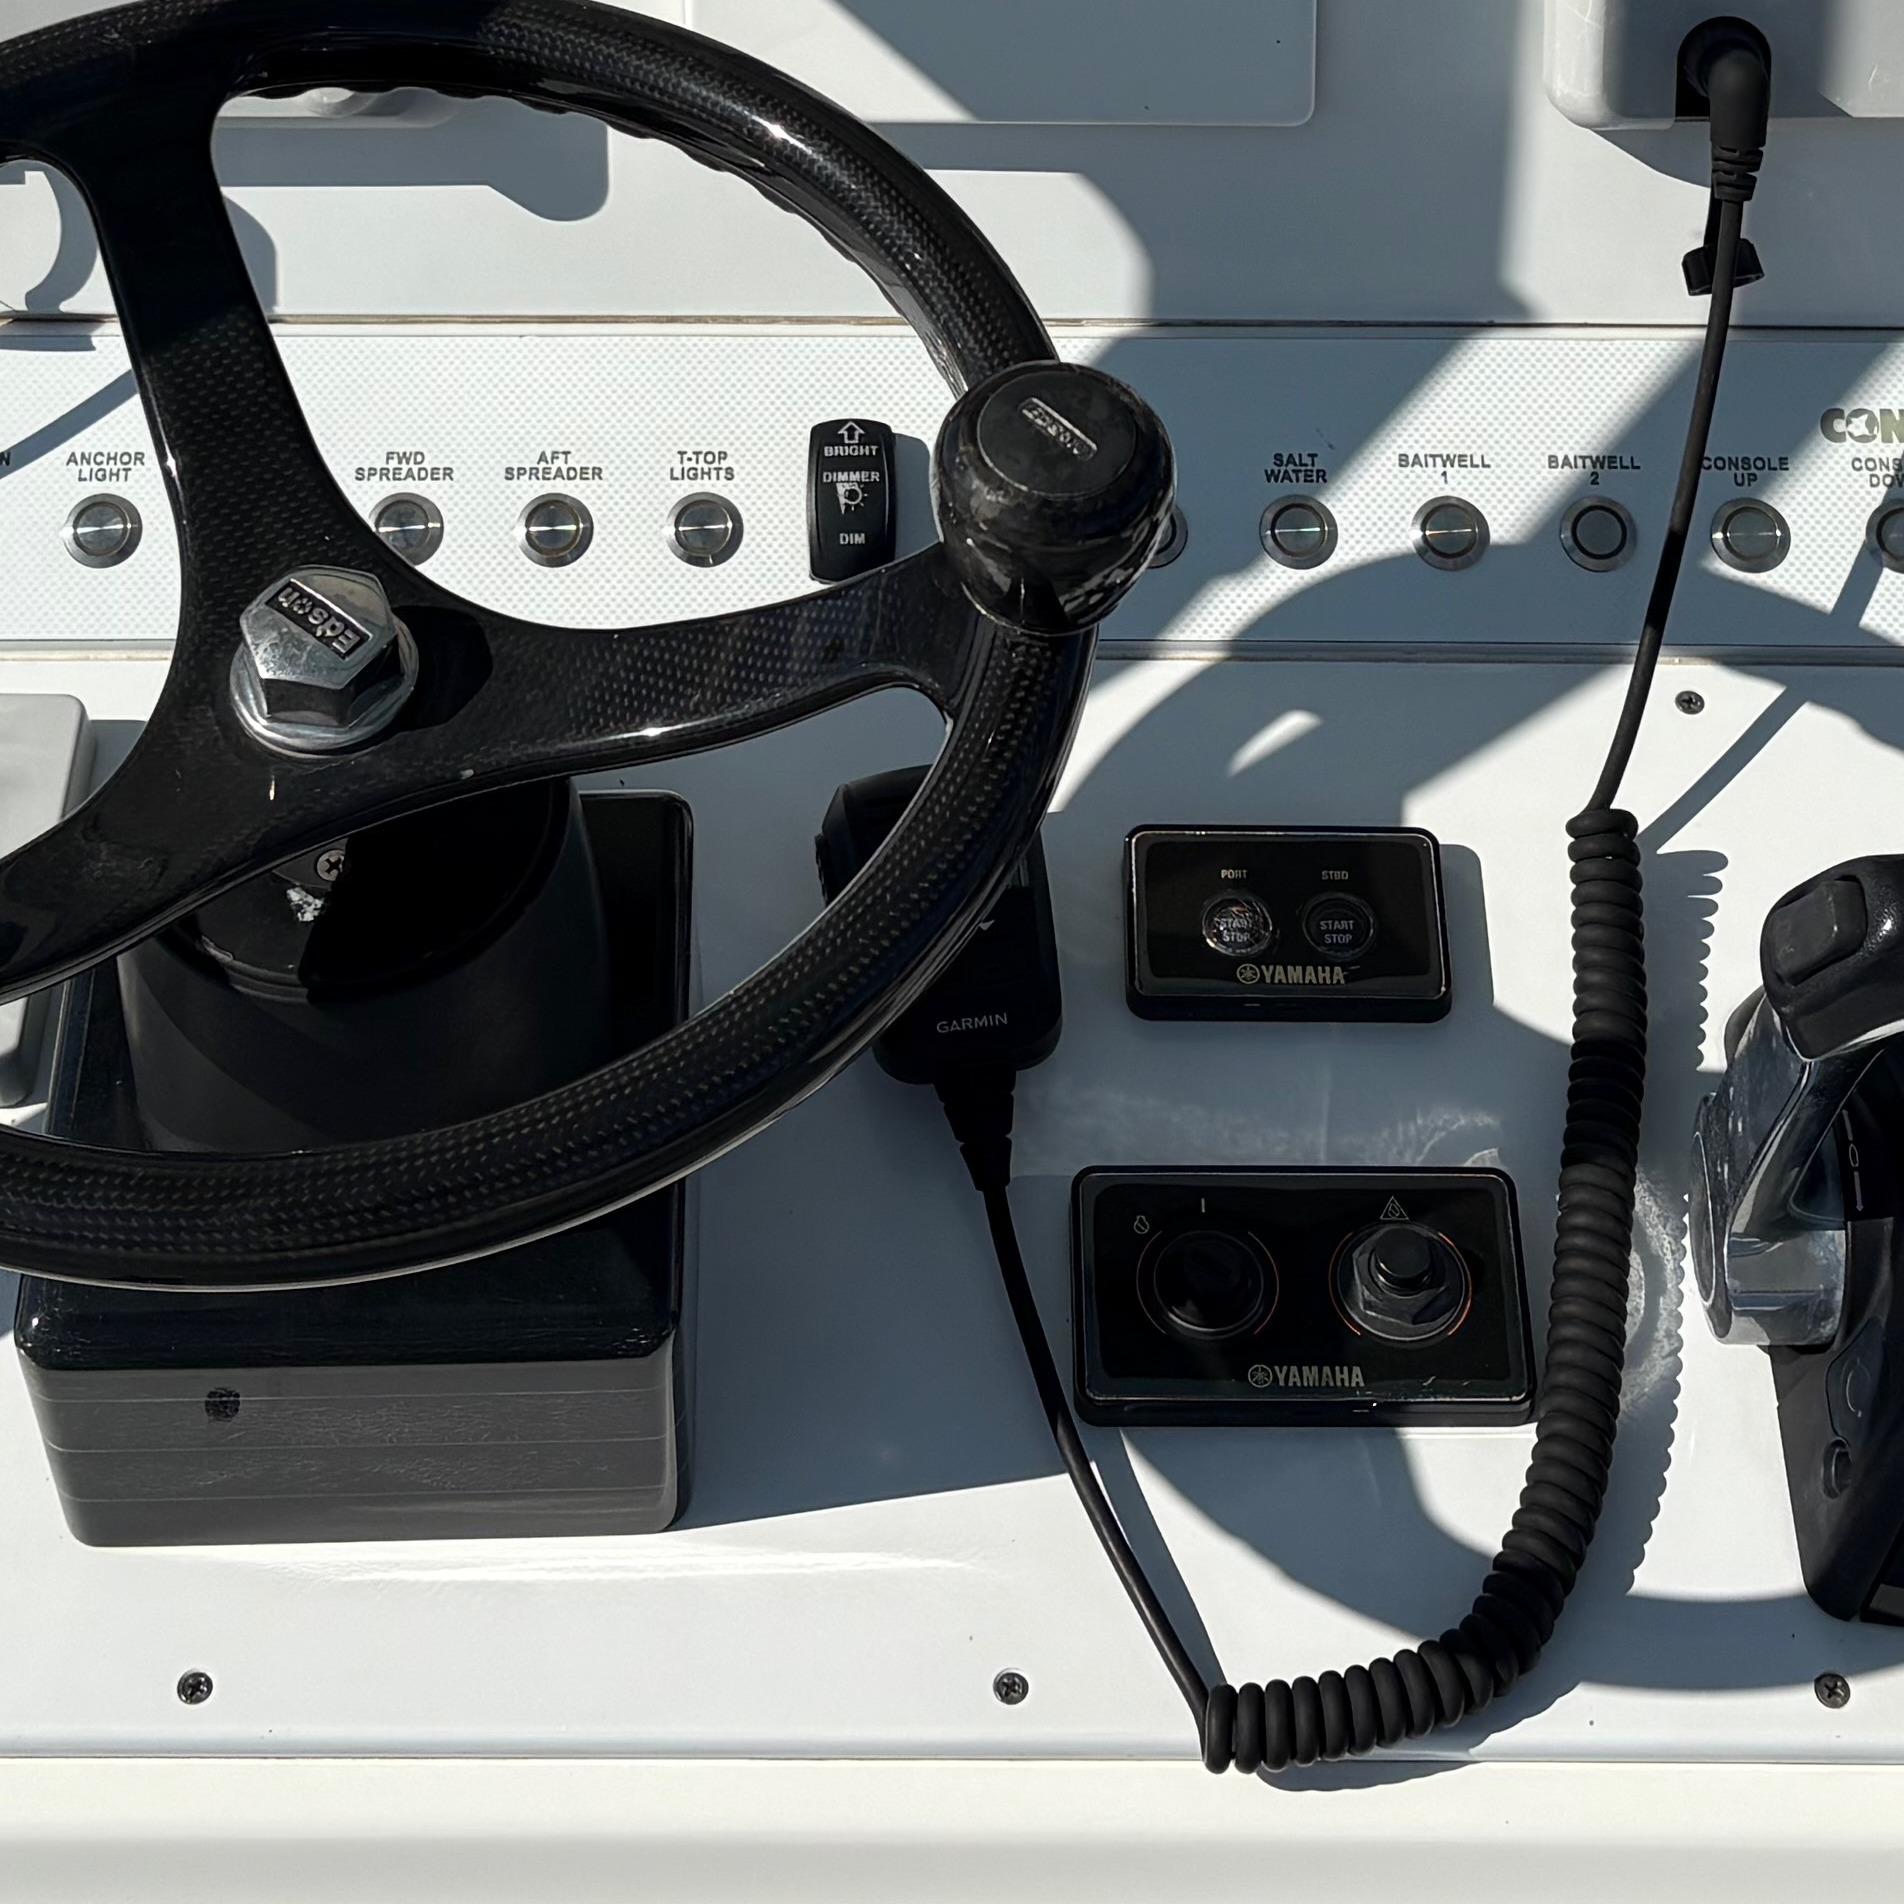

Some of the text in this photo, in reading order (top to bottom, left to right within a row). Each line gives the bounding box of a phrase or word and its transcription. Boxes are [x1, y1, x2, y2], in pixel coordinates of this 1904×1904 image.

[65, 451, 146, 466] ANCHOR
[385, 451, 426, 466] FWD
[536, 450, 573, 465] AFT
[676, 450, 729, 465] T-TOP
[823, 445, 879, 457] BRIGHT
[1273, 452, 1319, 467] SALT
[1397, 453, 1492, 469] BAITWELL
[1546, 454, 1642, 470] BAITWELL
[1701, 456, 1790, 472] CONSOLE
[77, 467, 132, 482] LIGHT
[354, 467, 455, 482] SPREADER
[503, 466, 604, 481] SPREADER
[669, 466, 736, 481] LIGHTS
[822, 471, 881, 483] DIMMER
[1264, 468, 1328, 484] WATER
[1440, 470, 1449, 485] 1
[1589, 471, 1600, 486] 2
[1733, 473, 1759, 487] UP
[839, 532, 866, 545] DIM
[1220, 869, 1349, 881] PORT STBD
[1319, 919, 1354, 931] START
[1324, 933, 1353, 945] STOP
[1260, 965, 1346, 985] YAMAHA
[936, 1012, 1009, 1034] GARMIN
[1273, 1365, 1366, 1388] YAMAHA
